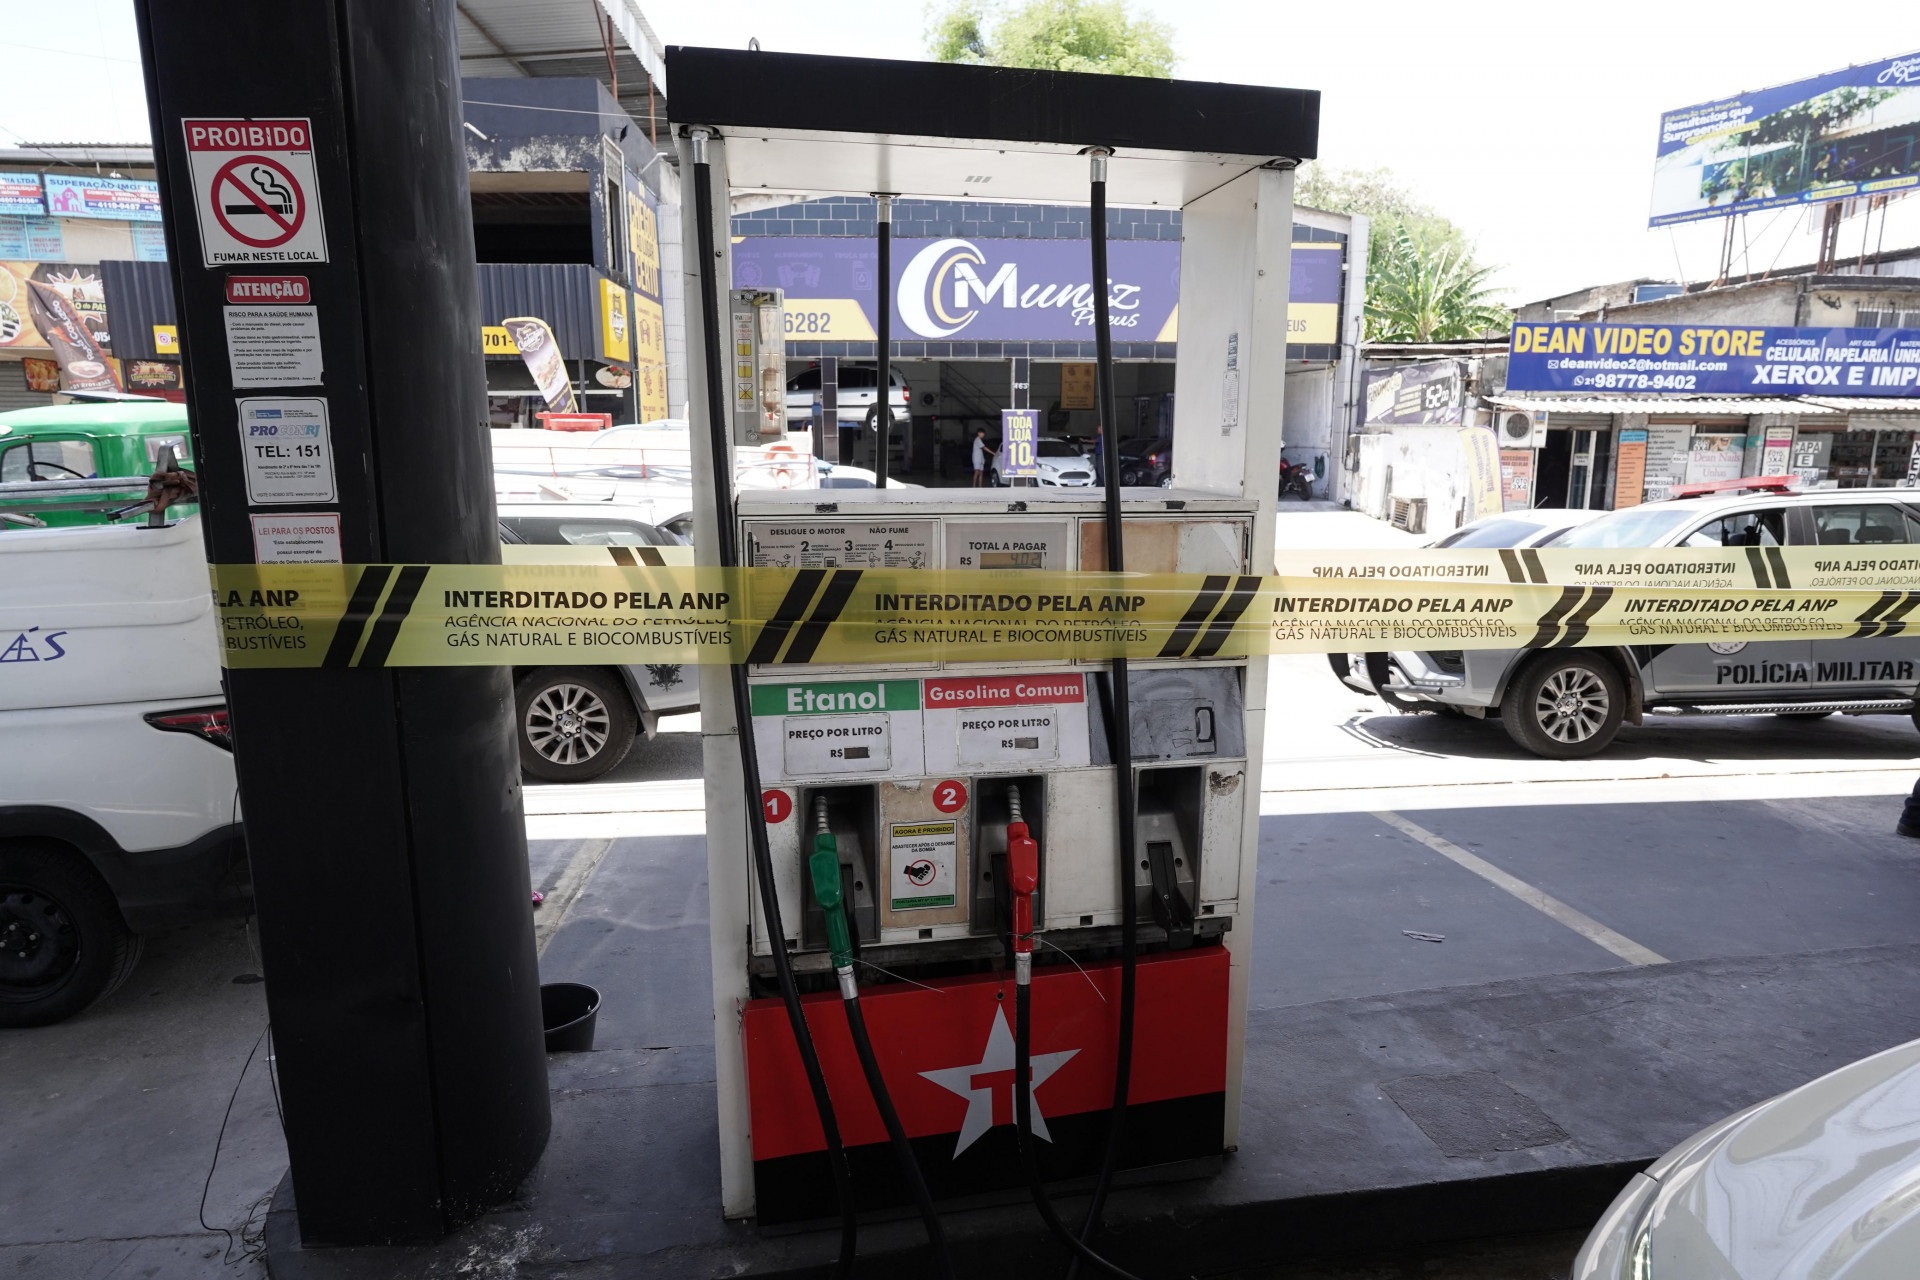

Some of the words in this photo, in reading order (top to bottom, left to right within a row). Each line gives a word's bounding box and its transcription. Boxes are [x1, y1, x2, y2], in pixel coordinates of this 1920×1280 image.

[1664, 111, 1728, 132] Resultados
[1729, 105, 1754, 119] que
[1662, 115, 1746, 142] Surpreendem!
[191, 127, 305, 147] PROIBIDO
[50, 179, 115, 190] SUPERAÇÃO
[214, 252, 249, 262] FUMAR
[252, 252, 285, 261] NESTE
[288, 251, 319, 260] LOCAL
[232, 280, 304, 299] ATENÇÃO
[269, 310, 288, 318] SAÚDE
[783, 312, 831, 333] 6282
[1513, 326, 1586, 354] DEAN
[1594, 328, 1672, 355] VIDEO
[1678, 329, 1765, 356] STORE
[1776, 338, 1816, 346] ACESSÓRIOS
[1766, 346, 1820, 362] CELULAR
[1824, 348, 1888, 362] PAPELARIA
[1560, 358, 1728, 372] deanvideo2@hotmail.com
[1595, 374, 1696, 390] 98778-9402
[1752, 365, 1842, 385] XEROX
[1847, 366, 1865, 386] E
[1006, 416, 1033, 429] TODA
[1009, 429, 1032, 441] LOJA
[254, 446, 290, 458] TEL:
[296, 444, 321, 458] 151
[1795, 442, 1821, 453] CAPA
[1694, 452, 1717, 462] Dean
[1719, 452, 1740, 462] Nails
[1802, 455, 1810, 464] E
[258, 528, 270, 536] LEI
[292, 527, 304, 535] OS
[306, 526, 336, 534] POSTOS
[770, 528, 807, 536] DESLIGUE
[869, 526, 887, 534] NÃO
[755, 542, 760, 553] 1
[801, 541, 809, 552] 2
[845, 540, 853, 551] 3
[884, 540, 893, 550] 4
[969, 542, 1001, 551] TOTAL
[1002, 542, 1010, 550] A
[1012, 542, 1047, 551] PAGAR
[960, 556, 972, 566] R$
[250, 590, 299, 607] ANP
[444, 590, 608, 609] INTERDITADO
[614, 592, 673, 610] PELA
[679, 592, 730, 610] ANP
[875, 594, 1032, 612] INTERDITADO
[1037, 595, 1093, 612] PELA
[1098, 595, 1146, 612] ANP
[1273, 597, 1413, 613] INTERDITADO
[1416, 598, 1466, 613] PELA
[1470, 598, 1514, 613] ANP
[1624, 599, 1749, 612] INTERDITADO
[1750, 599, 1799, 612] PELA
[1798, 599, 1838, 612] ANP
[445, 614, 517, 628] AGÊNCIA
[447, 630, 480, 648] GÁS
[487, 632, 562, 646] NATURAL
[568, 633, 577, 646] E
[583, 628, 732, 646] BIOCOMBUSTÍVEIS
[875, 627, 908, 644] GÁS
[914, 630, 987, 643] NATURAL
[993, 630, 1002, 642] E
[1008, 627, 1147, 643] BIOCOMBUSTÍVEIS
[1275, 626, 1305, 640] GÁS
[1310, 627, 1376, 640] NATURAL
[1380, 627, 1388, 639] E
[1394, 626, 1517, 639] BIOCOMBUSTÍVEIS
[1717, 660, 1808, 685] POLÍCIA
[1817, 660, 1914, 683] MILITAR
[787, 683, 886, 712] Etanol
[929, 685, 1011, 702] Gasolina
[1015, 683, 1080, 698] Comum
[962, 720, 996, 731] PREÇO
[998, 720, 1019, 729] POR
[1021, 718, 1051, 727] LITRO
[788, 730, 824, 740] PREÇO
[827, 728, 850, 738] POR
[852, 726, 883, 736] LITRO
[1001, 738, 1014, 749] R$
[830, 748, 844, 759] R$
[942, 788, 957, 806] 2
[767, 798, 779, 816] 1
